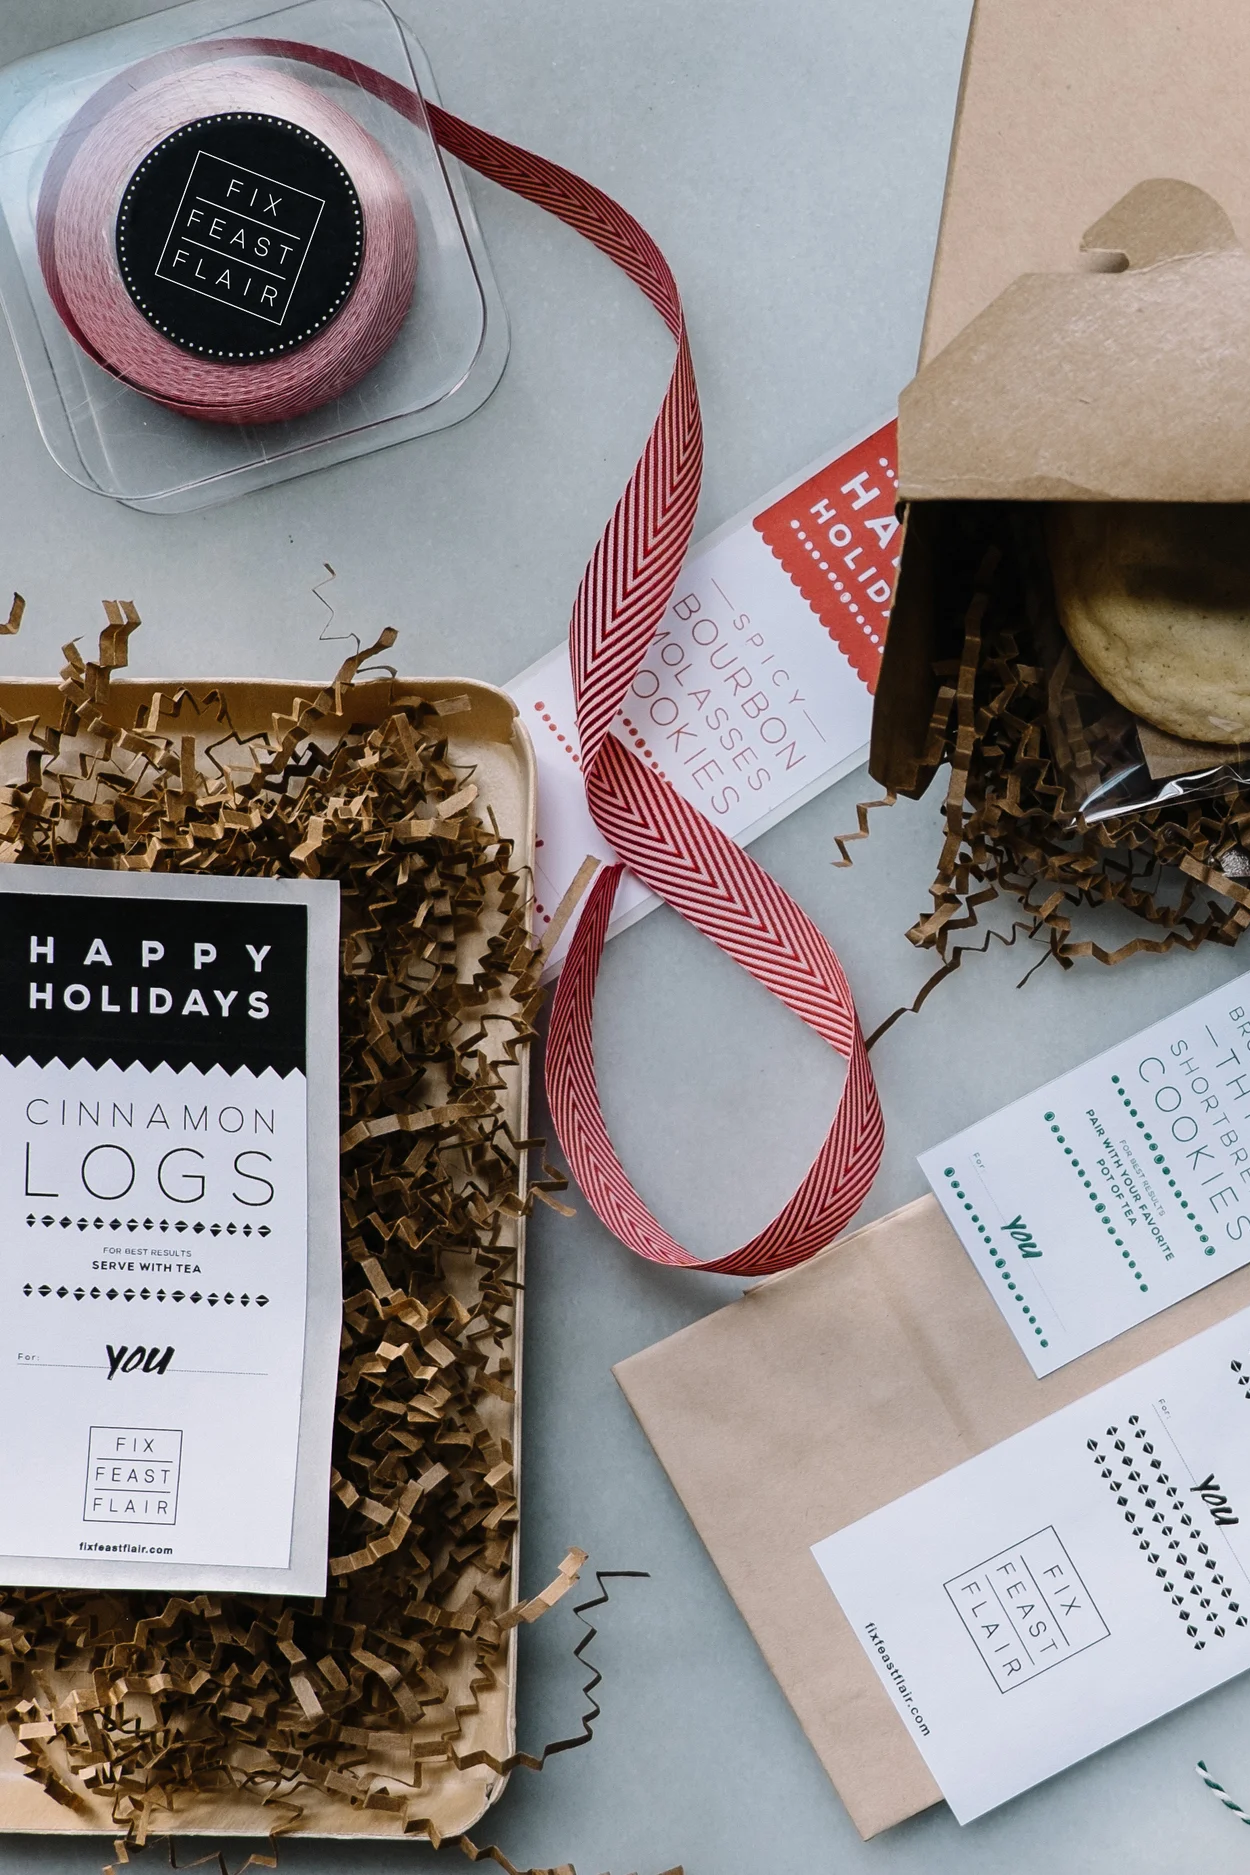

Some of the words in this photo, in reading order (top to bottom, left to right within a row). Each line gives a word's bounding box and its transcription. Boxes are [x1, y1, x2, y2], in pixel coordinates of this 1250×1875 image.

[226, 179, 282, 217] FIX
[186, 209, 294, 265] FEAST
[172, 249, 278, 307] FLAIR
[672, 592, 807, 772] BOURBON
[733, 613, 806, 706] SPICY
[30, 935, 271, 972] HAPPY
[29, 982, 270, 1020] HOLIDAYS
[26, 1098, 274, 1134] CINNAMON
[25, 1141, 274, 1206] LOGS
[1085, 1108, 1106, 1137] PAIR
[1102, 1137, 1124, 1169] WITH
[1120, 1169, 1142, 1203] YOUR
[1138, 1204, 1175, 1261] FAVORITE
[1096, 1158, 1115, 1182] POT
[1110, 1184, 1125, 1200] OF
[1121, 1202, 1137, 1226] TEA
[1119, 1139, 1133, 1158] FOR
[1130, 1158, 1146, 1179] BEST
[1142, 1179, 1166, 1217] RESULTS
[103, 1246, 122, 1255] FOR
[124, 1248, 148, 1256] BEST
[151, 1249, 192, 1257] RESULTS
[1000, 1214, 1043, 1259] you
[92, 1260, 135, 1271] SERVE
[139, 1262, 172, 1272] WITH
[176, 1263, 202, 1274] TEA
[105, 1344, 175, 1381] you
[115, 1437, 155, 1453] FIX
[94, 1466, 171, 1484] FEAST
[1190, 1473, 1239, 1526] you
[93, 1497, 169, 1515] FLAIR
[78, 1541, 173, 1555] fixfeastflair.com
[996, 1561, 1059, 1655] FEAST
[1043, 1564, 1082, 1616] FIX
[961, 1580, 1023, 1677] FLAIR
[864, 1621, 931, 1737] fixfeastflair.com
